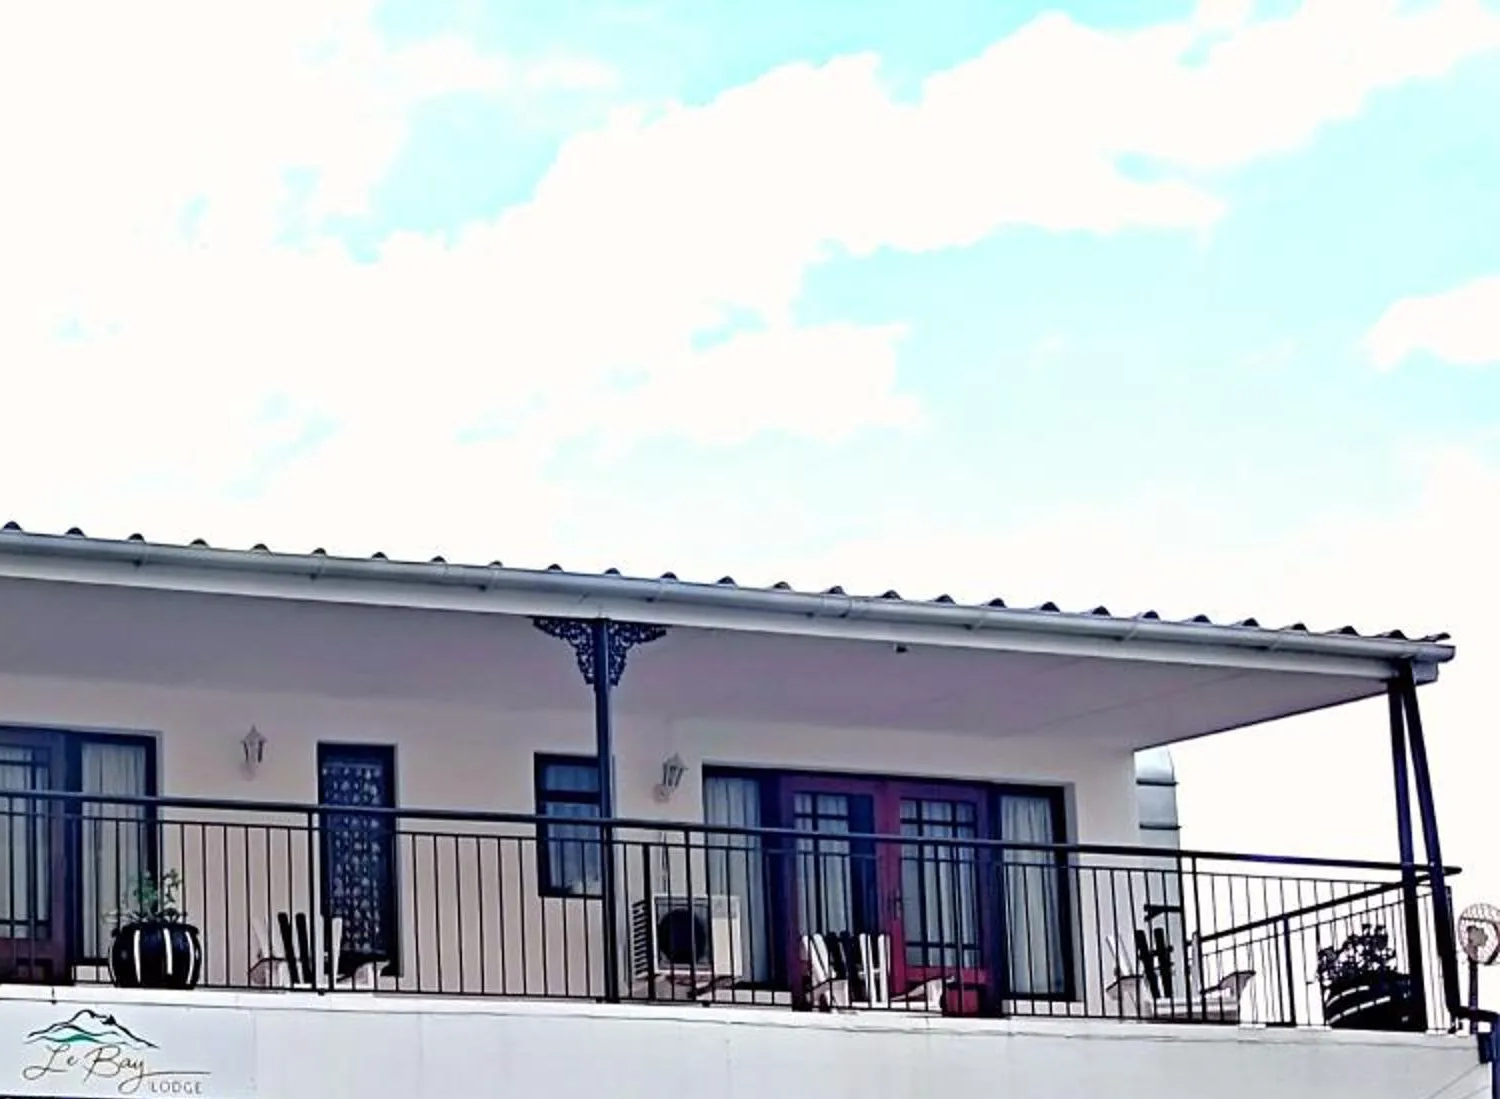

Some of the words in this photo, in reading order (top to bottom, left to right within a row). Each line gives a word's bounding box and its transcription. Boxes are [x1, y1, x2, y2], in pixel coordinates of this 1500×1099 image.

[23, 1044, 77, 1080] Le
[83, 1044, 150, 1094] Bay
[150, 1080, 203, 1095] LODGE
